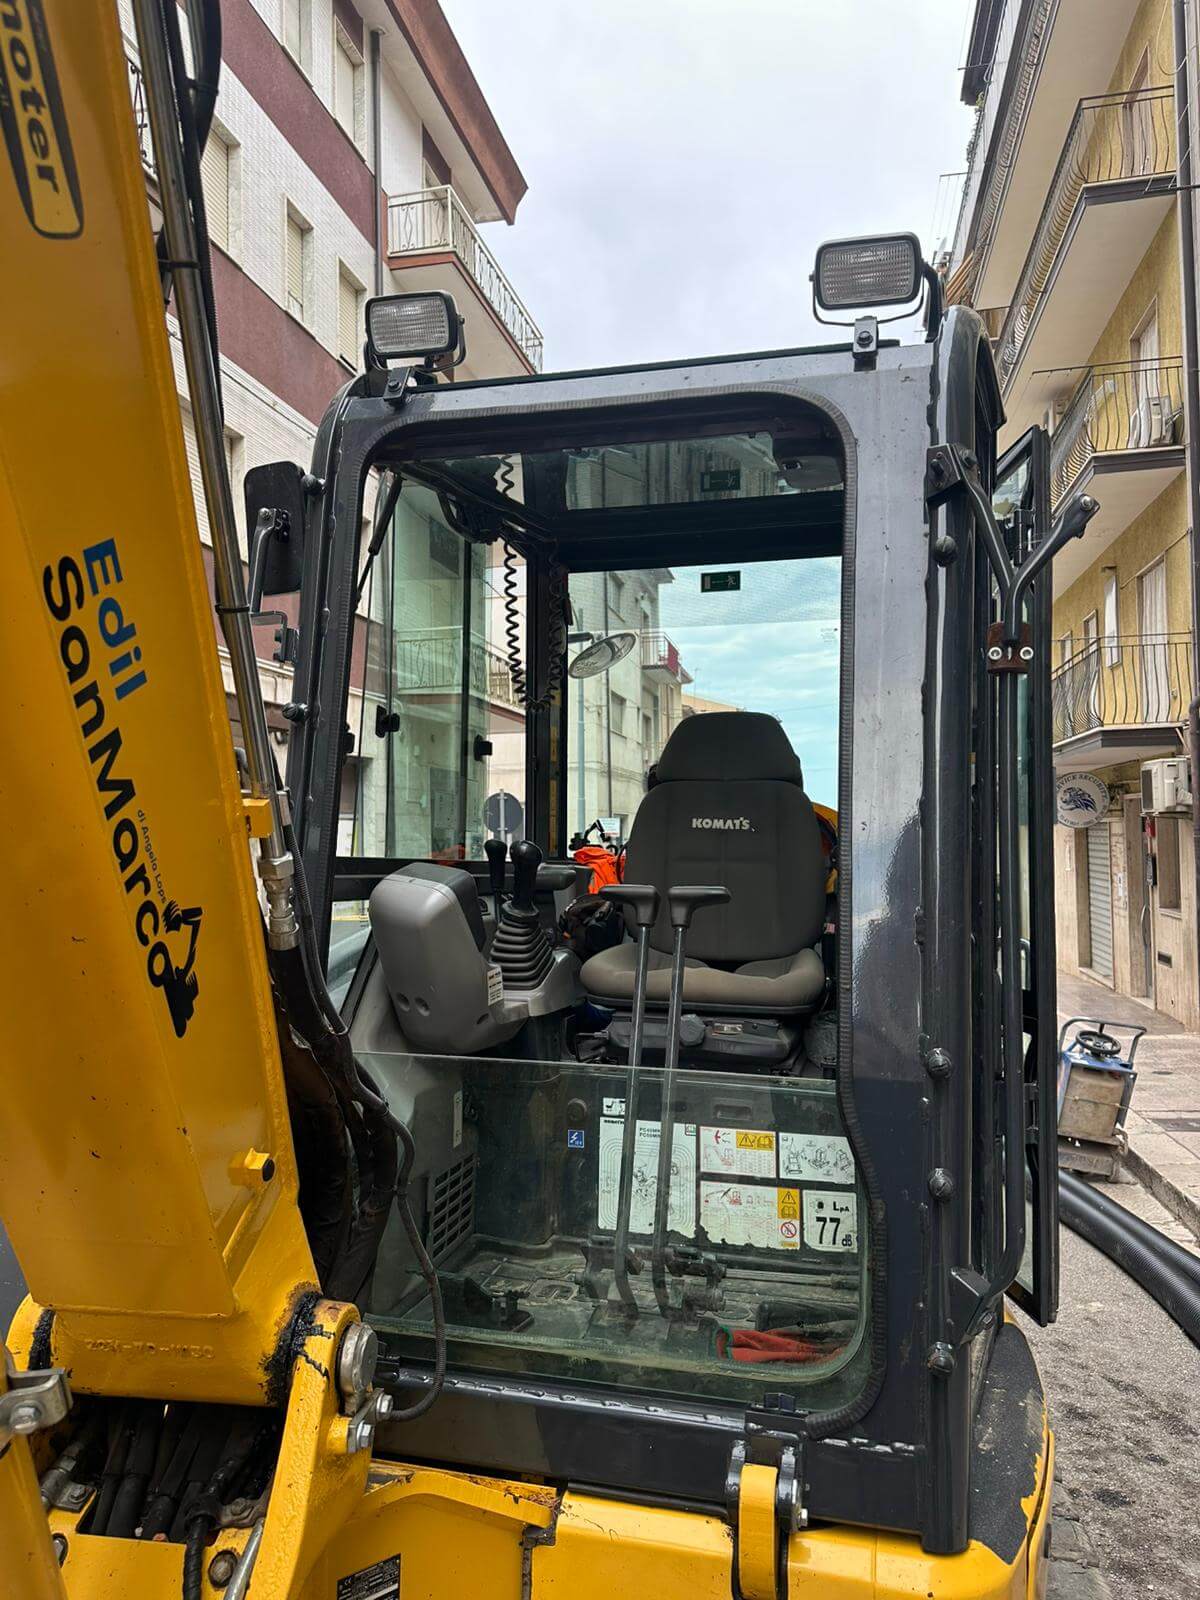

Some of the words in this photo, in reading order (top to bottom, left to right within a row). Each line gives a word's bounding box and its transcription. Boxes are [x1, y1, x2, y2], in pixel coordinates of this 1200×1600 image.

[83, 538, 147, 702] Edil
[43, 556, 178, 988] SanMarco
[138, 809, 146, 821] di
[141, 826, 158, 871] Angelo
[155, 873, 167, 904] Lops
[816, 1216, 841, 1245] 77
